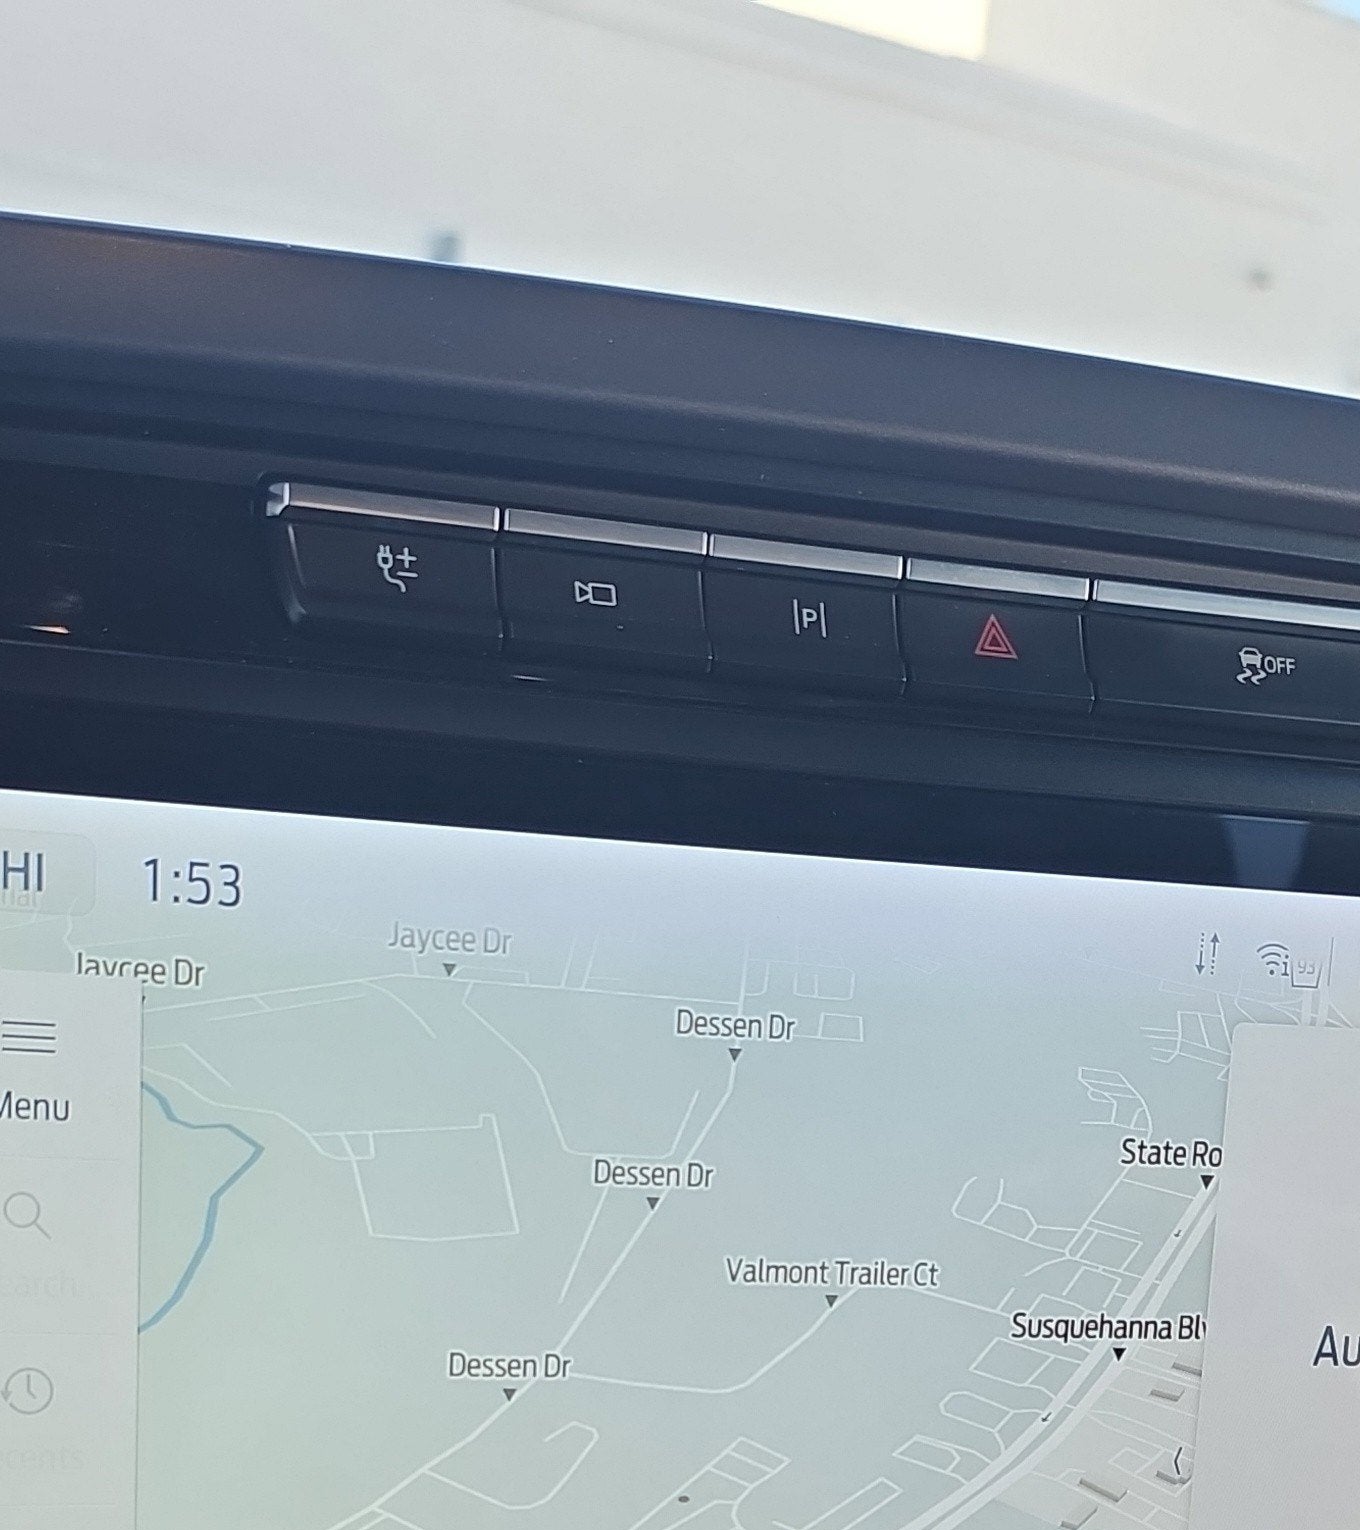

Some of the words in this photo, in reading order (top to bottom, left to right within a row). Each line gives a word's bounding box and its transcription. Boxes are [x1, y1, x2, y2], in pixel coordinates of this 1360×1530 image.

[1264, 655, 1296, 675] OFF
[2, 850, 43, 892] HI
[144, 858, 241, 907] 1:53
[388, 921, 476, 955] Jaycee
[483, 928, 512, 955] Dr
[174, 958, 205, 986] Dr
[677, 1008, 762, 1039] Dessen
[768, 1013, 796, 1041] Dr
[1121, 1137, 1187, 1166] State
[1192, 1140, 1223, 1168] Ro
[594, 1158, 681, 1187] Dessen
[687, 1162, 715, 1188] Dr
[726, 1258, 829, 1284] Valmont
[835, 1260, 910, 1286] Trailer
[914, 1262, 939, 1287] Ct
[1011, 1312, 1172, 1343] Susquehanna
[449, 1351, 538, 1379] Dessen
[544, 1353, 571, 1378] Dr
